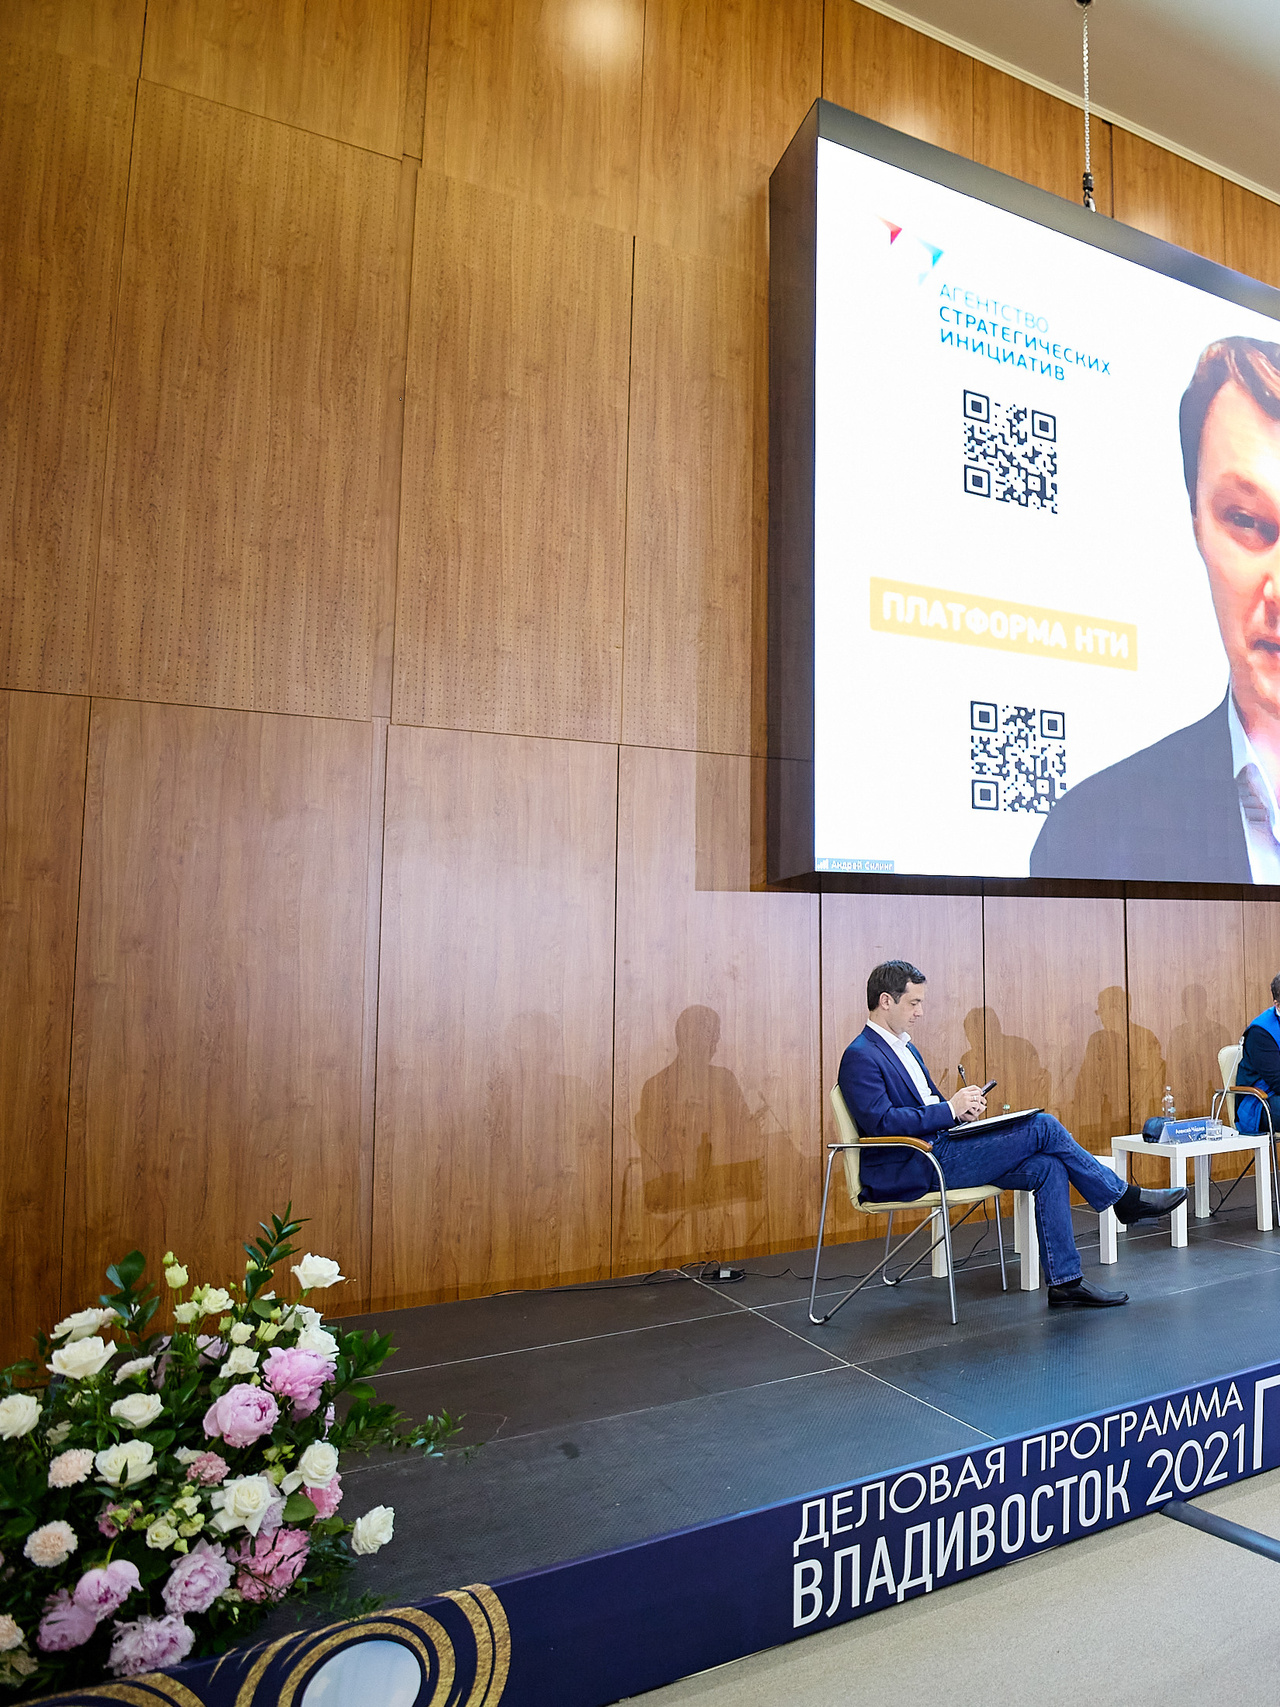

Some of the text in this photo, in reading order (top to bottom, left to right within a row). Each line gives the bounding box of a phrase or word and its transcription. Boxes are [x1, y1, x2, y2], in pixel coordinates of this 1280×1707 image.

[939, 284, 1049, 334] АГЕНТСТВО
[939, 306, 1111, 376] СТРАТЕГИЧЕСКИХ
[940, 328, 1065, 381] ИНИЦИАТИВ
[882, 590, 1129, 659] ПЛАТФОРМА НТИ
[793, 1381, 1244, 1558] ДЕЛОВАЯ ПРОГРАММА
[792, 1422, 1246, 1629] ВЛАДИВОСТОК 2021
